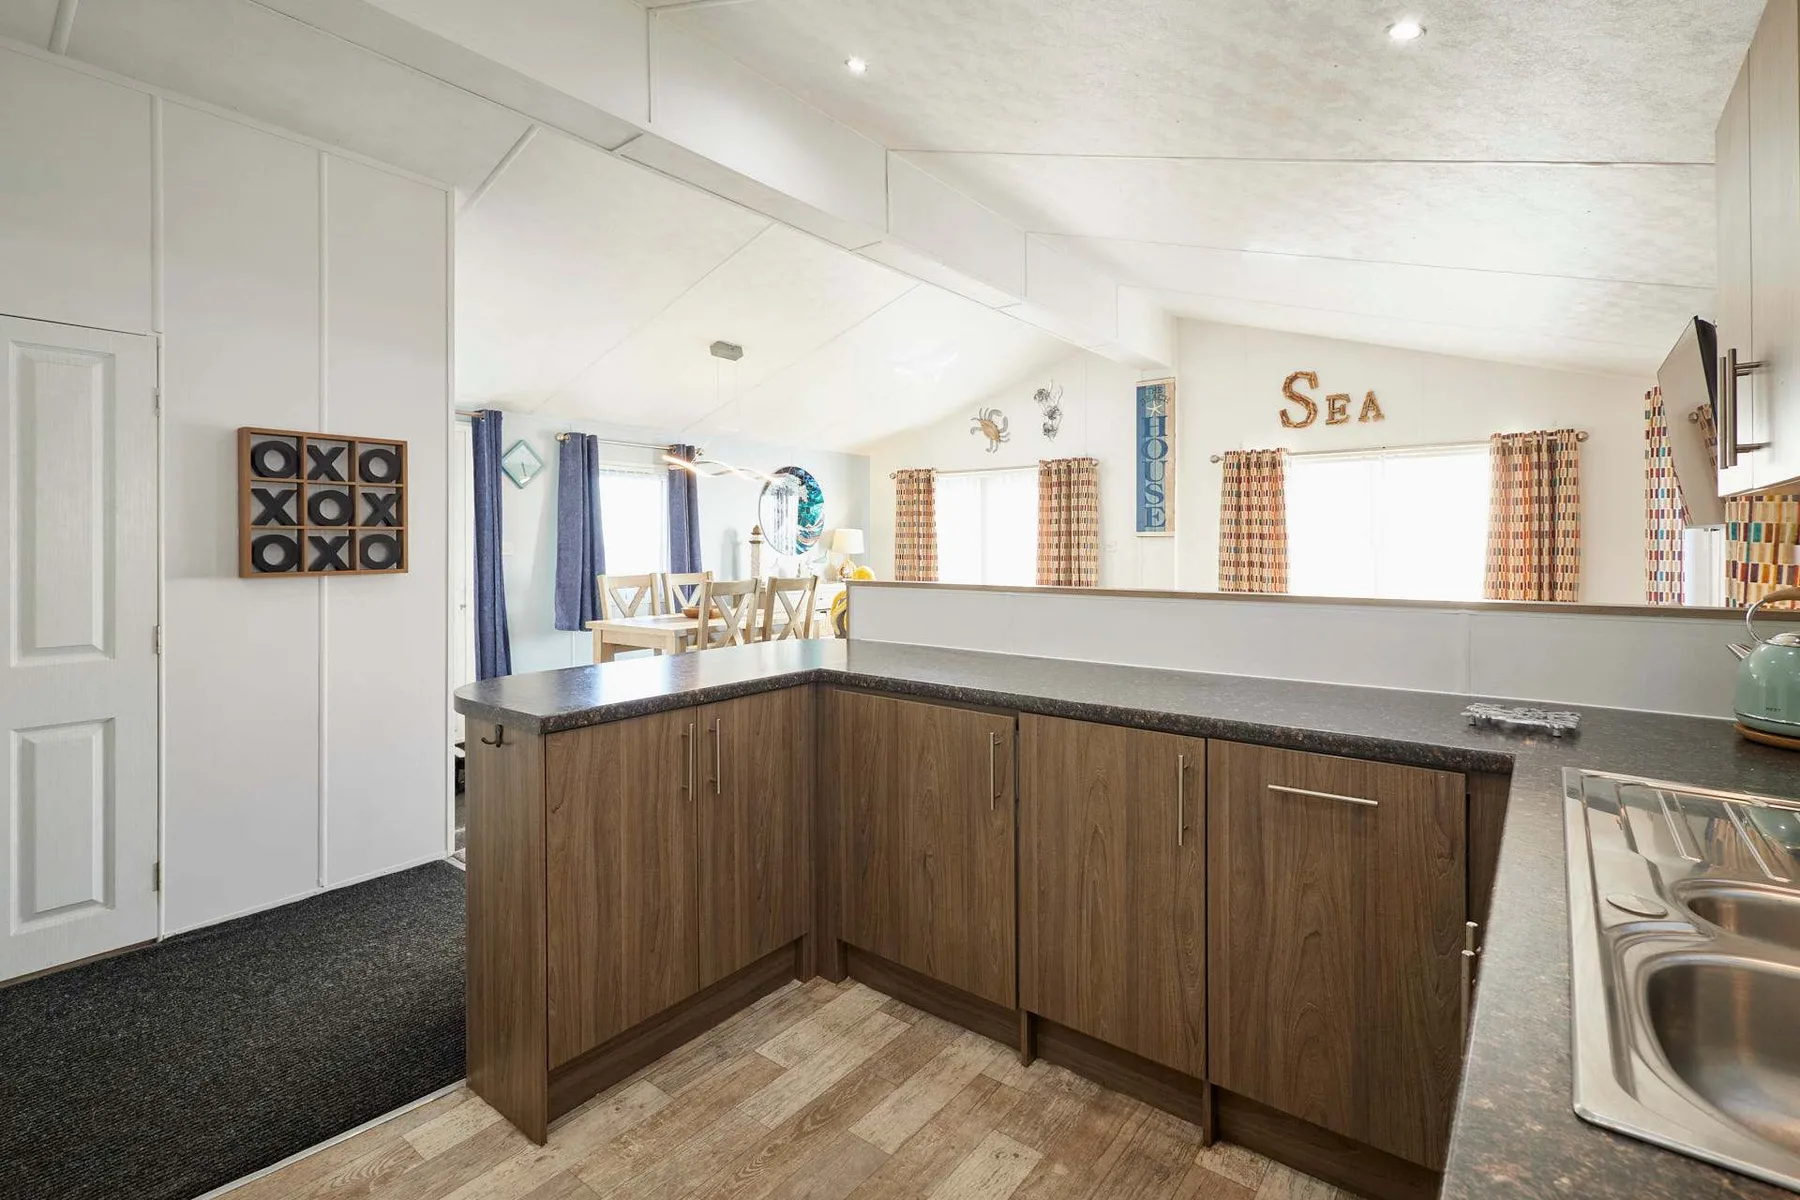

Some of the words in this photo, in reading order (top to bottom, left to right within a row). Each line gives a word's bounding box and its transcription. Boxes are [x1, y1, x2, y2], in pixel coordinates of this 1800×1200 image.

[1146, 385, 1164, 394] THE
[1279, 371, 1385, 428] SEA
[1141, 415, 1169, 528] HOUSE
